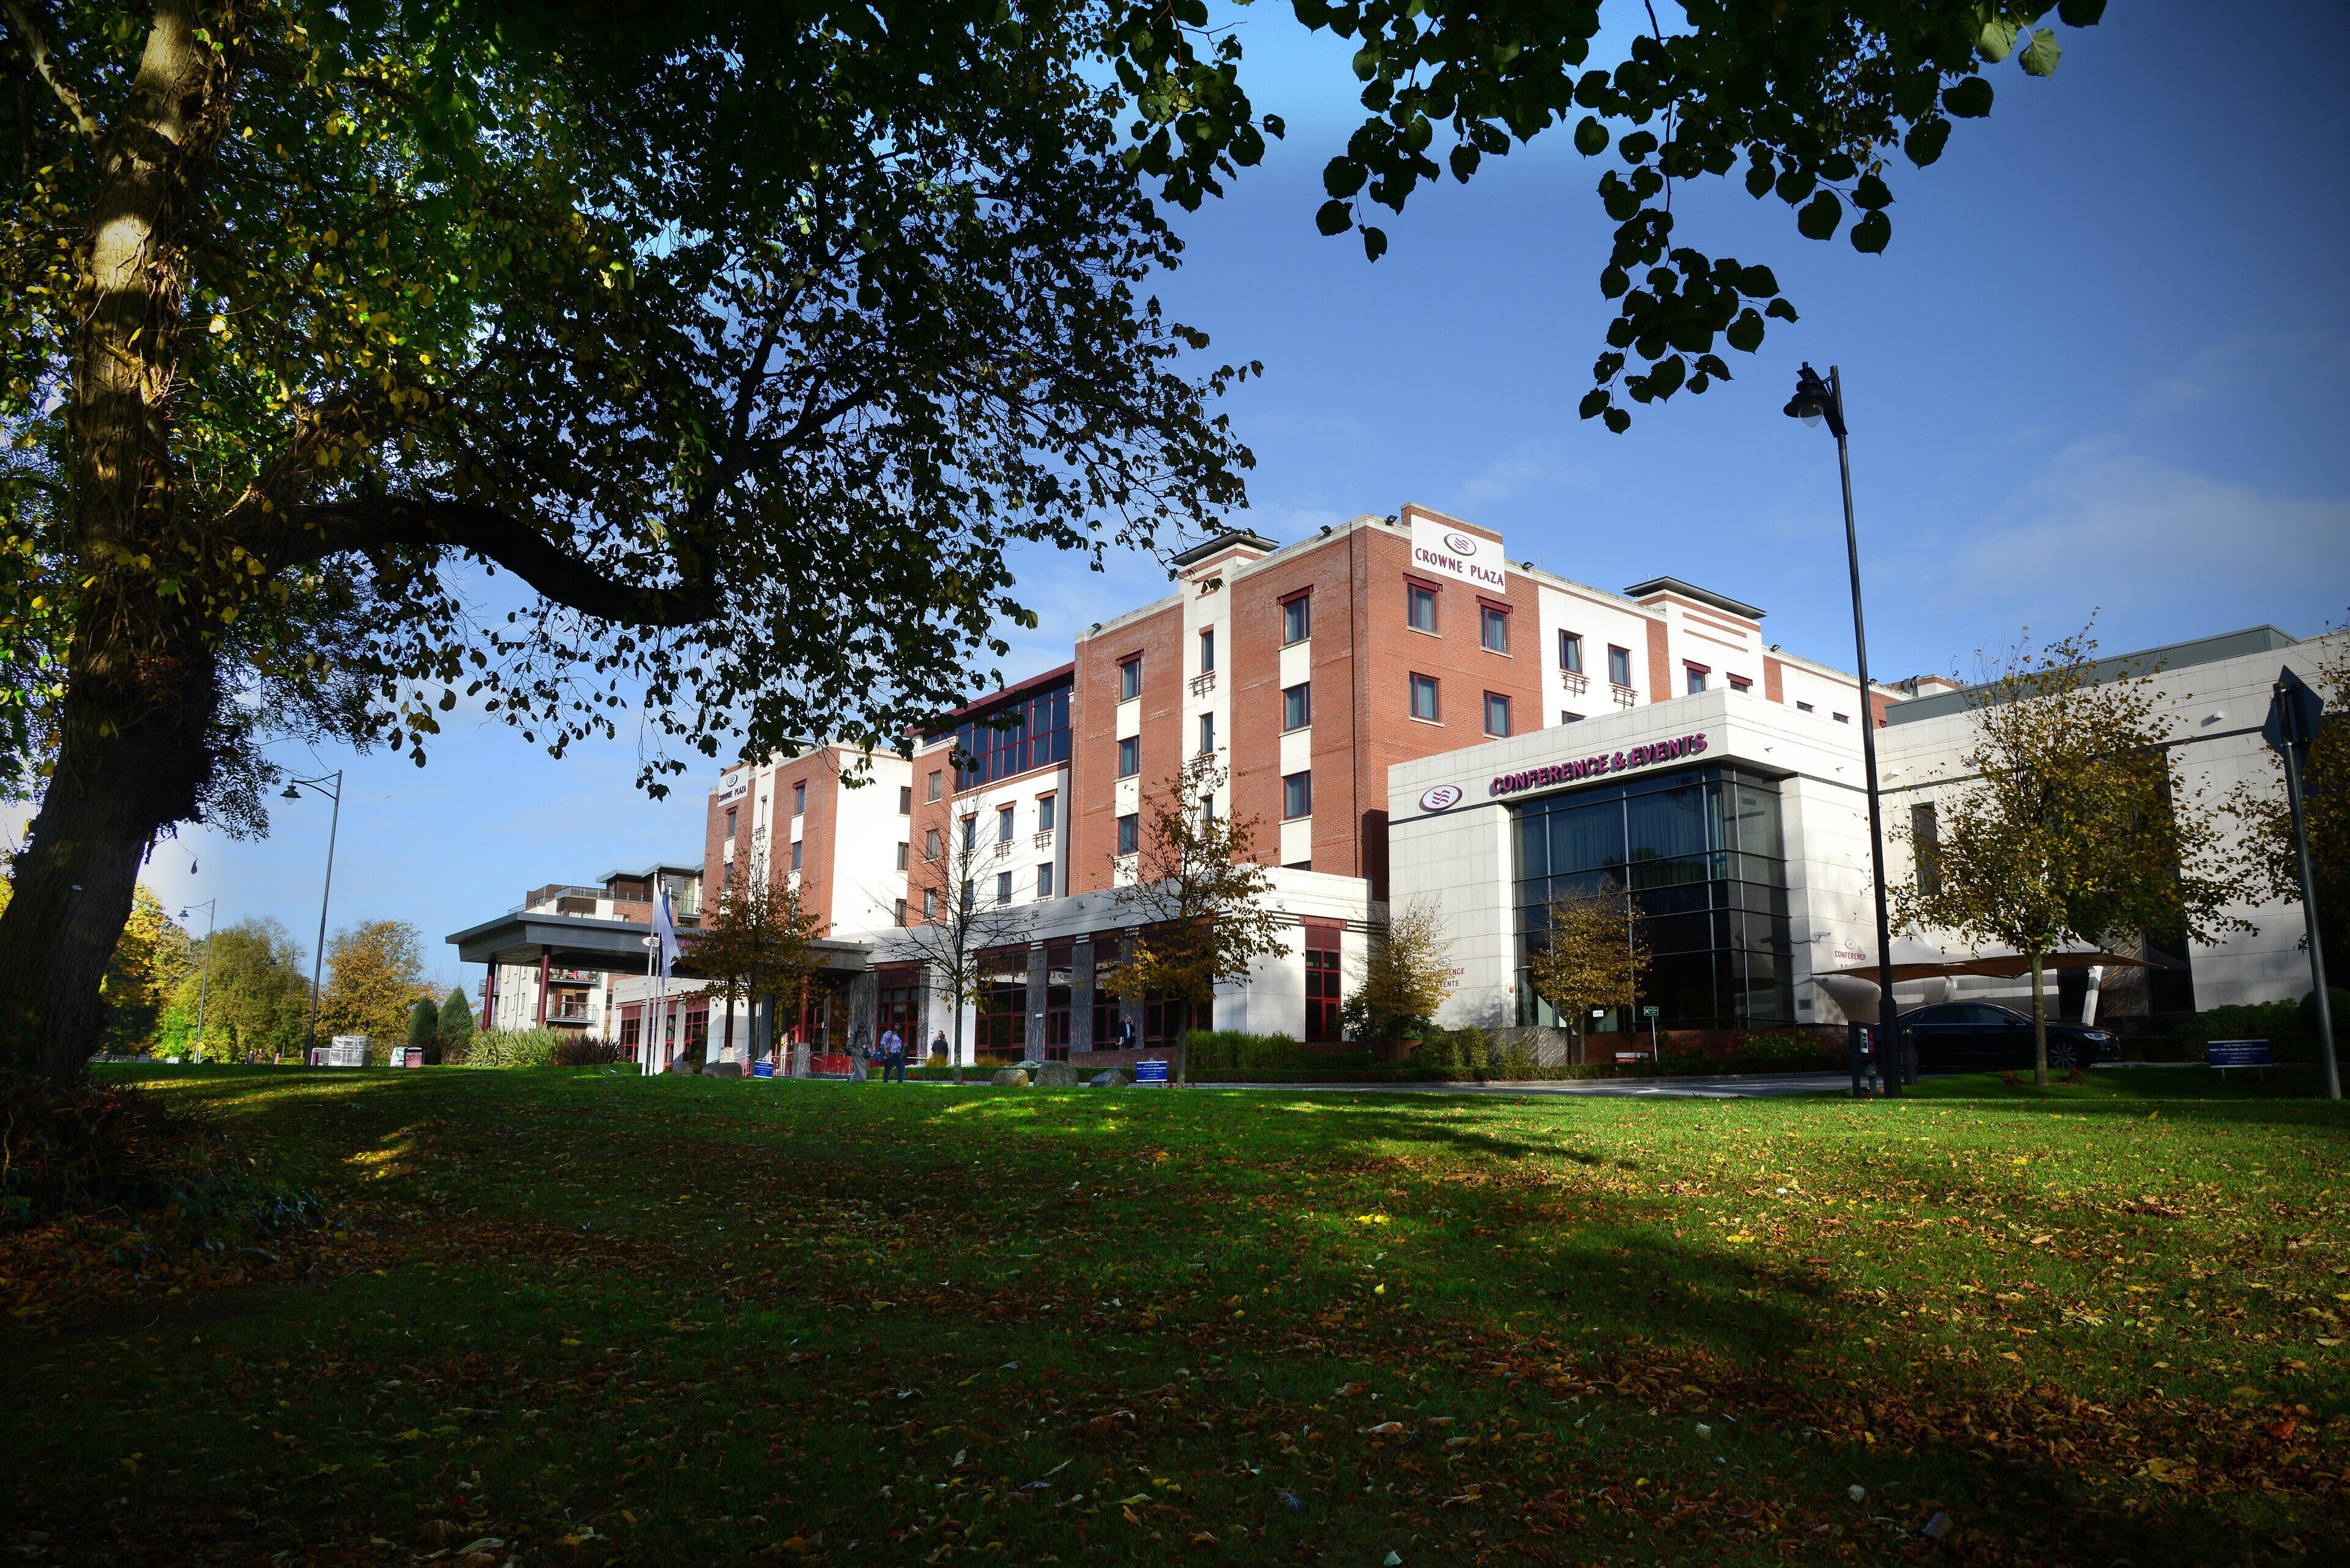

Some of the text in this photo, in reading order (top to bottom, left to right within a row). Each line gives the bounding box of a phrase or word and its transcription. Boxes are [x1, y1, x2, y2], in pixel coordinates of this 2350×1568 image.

[1415, 547, 1504, 586] CROWNE PLAZA
[1491, 732, 1708, 793] CONFERENCE & EVENTS
[734, 785, 746, 796] PLAZA
[1835, 950, 1866, 961] CONFERENCE
